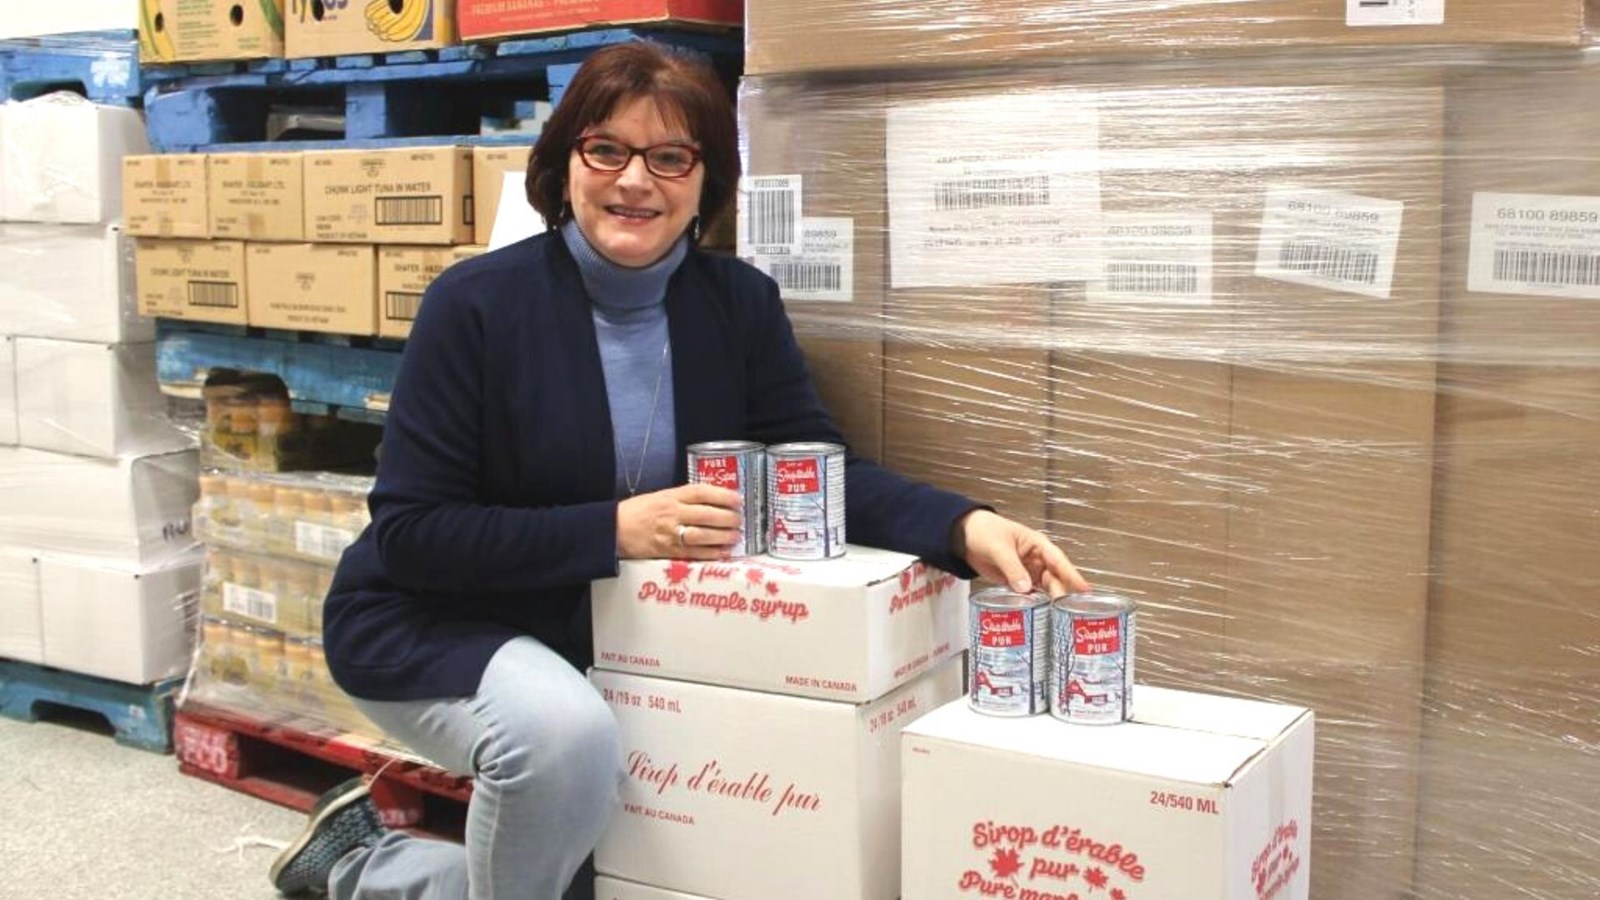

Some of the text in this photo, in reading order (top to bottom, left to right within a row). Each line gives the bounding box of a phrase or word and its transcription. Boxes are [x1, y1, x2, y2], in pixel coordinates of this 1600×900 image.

[351, 183, 372, 194] LIGHT
[374, 183, 394, 193] TUNA
[395, 182, 404, 192] IN
[405, 181, 431, 192] WATER
[1497, 207, 1598, 223] 68100 89859
[787, 483, 806, 492] PUR
[638, 581, 809, 623] Pure maple syrup
[991, 635, 1012, 646] PUR
[1087, 642, 1107, 654] PUR
[601, 651, 660, 667] FAIT AU CANADA
[785, 675, 857, 692] MADE IN CANADA
[603, 688, 614, 701] 24
[648, 695, 665, 710] 540
[686, 759, 773, 803] d'érable
[772, 783, 822, 816] pur
[1149, 790, 1219, 815] 24/540 ML
[624, 803, 695, 825] FAIT AU CANADA
[972, 820, 1146, 881] Sirop d'érable
[1029, 856, 1080, 881] pur
[959, 870, 1016, 900] Pure
